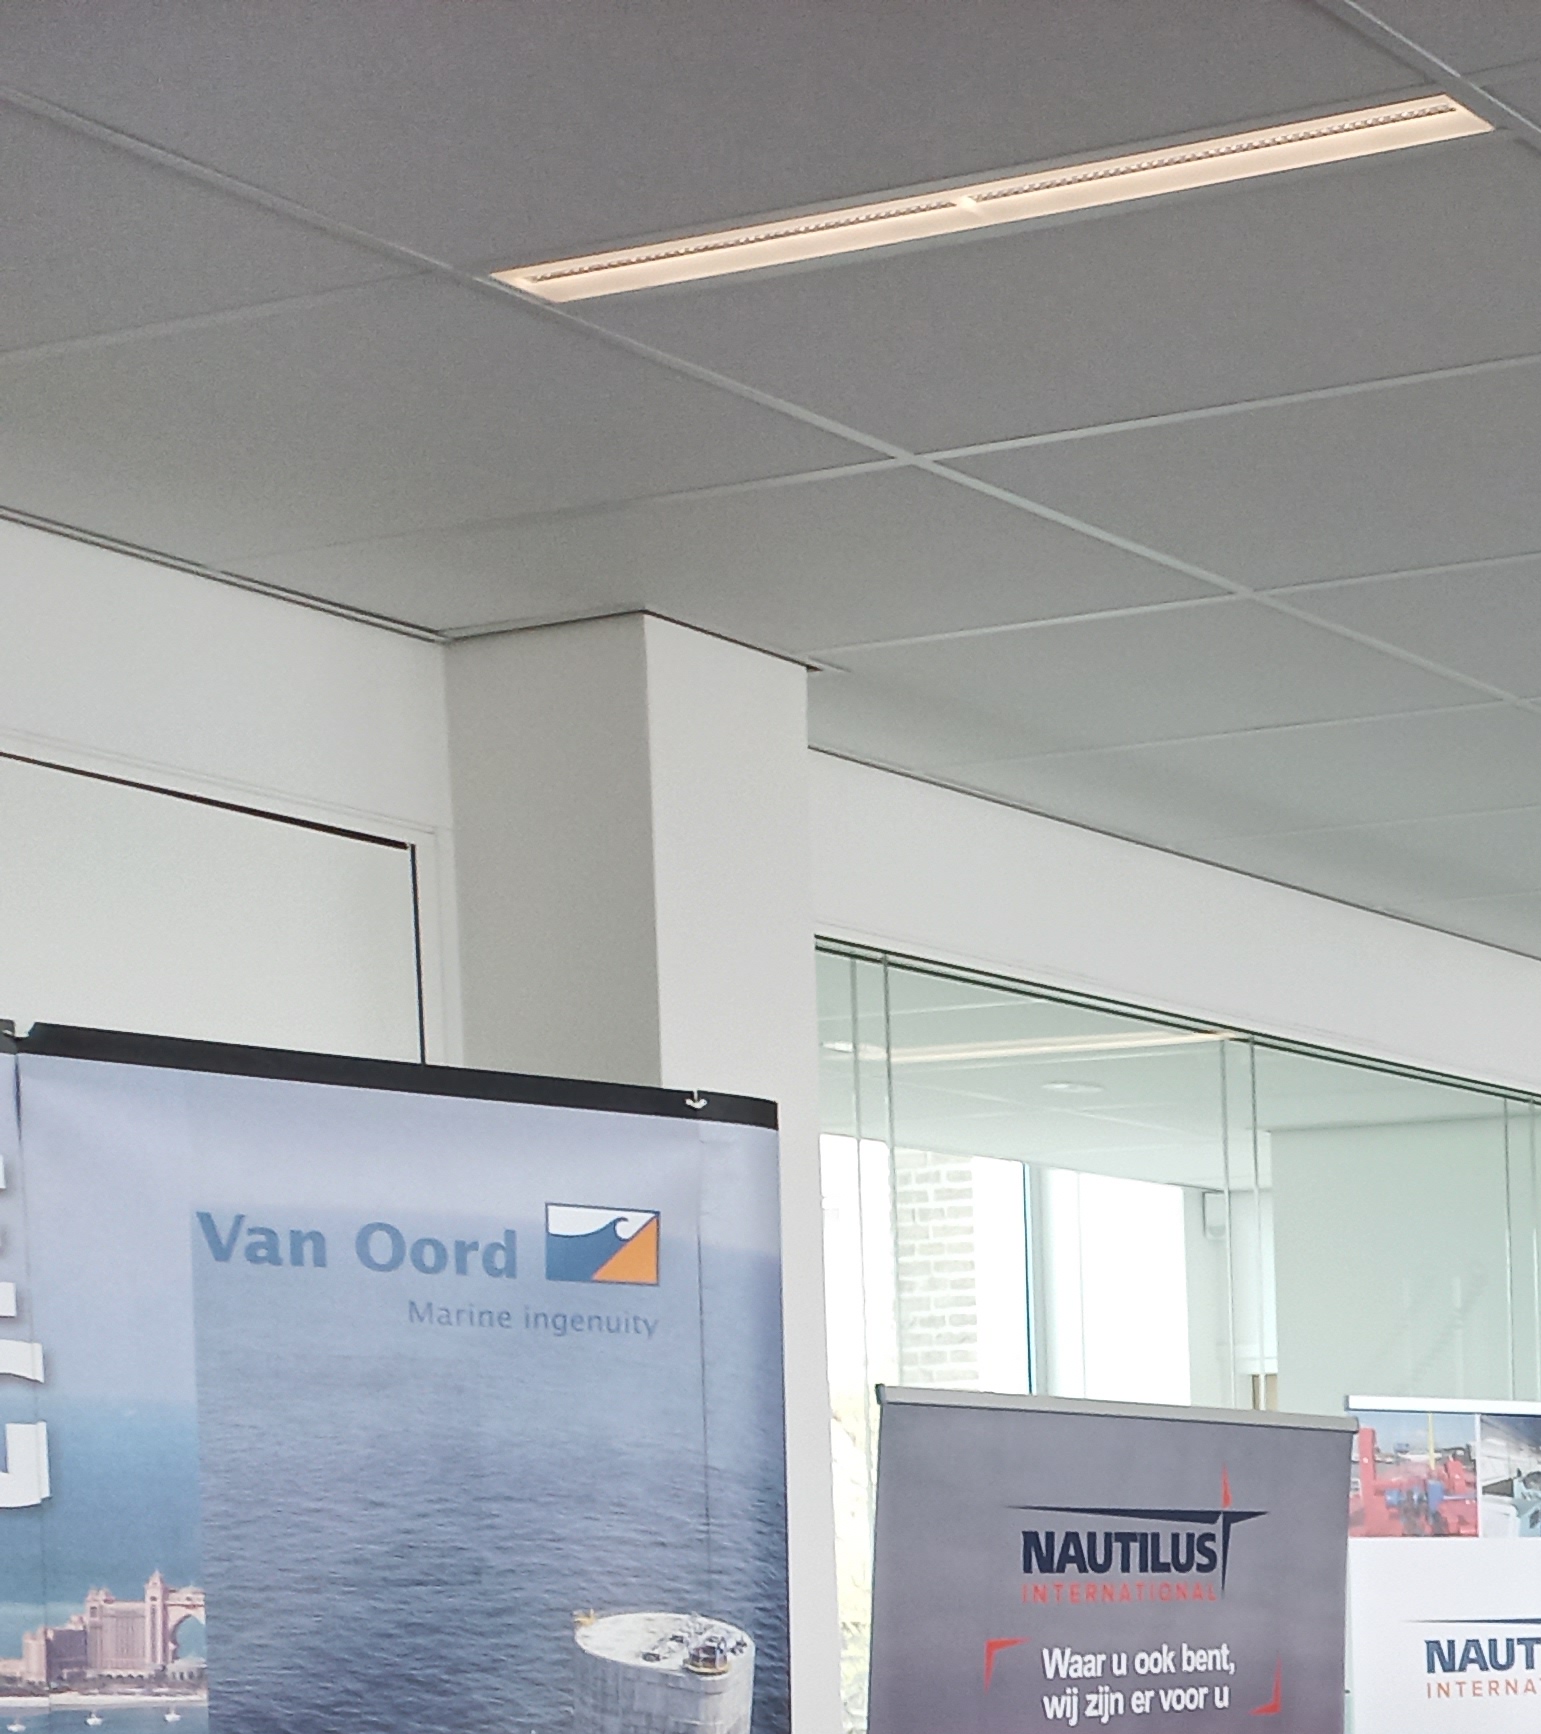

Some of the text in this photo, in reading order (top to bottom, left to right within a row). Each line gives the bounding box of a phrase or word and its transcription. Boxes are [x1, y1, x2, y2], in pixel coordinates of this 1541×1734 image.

[196, 1211, 517, 1279] Van Oord
[408, 1300, 660, 1341] Marine ingenuity
[1022, 1530, 1218, 1574] NAUTILUS
[1021, 1581, 1218, 1605] INTERNATIONAL
[1042, 1642, 1236, 1680] Waar u ook bent,
[1042, 1685, 1230, 1726] wij zijn er voor u
